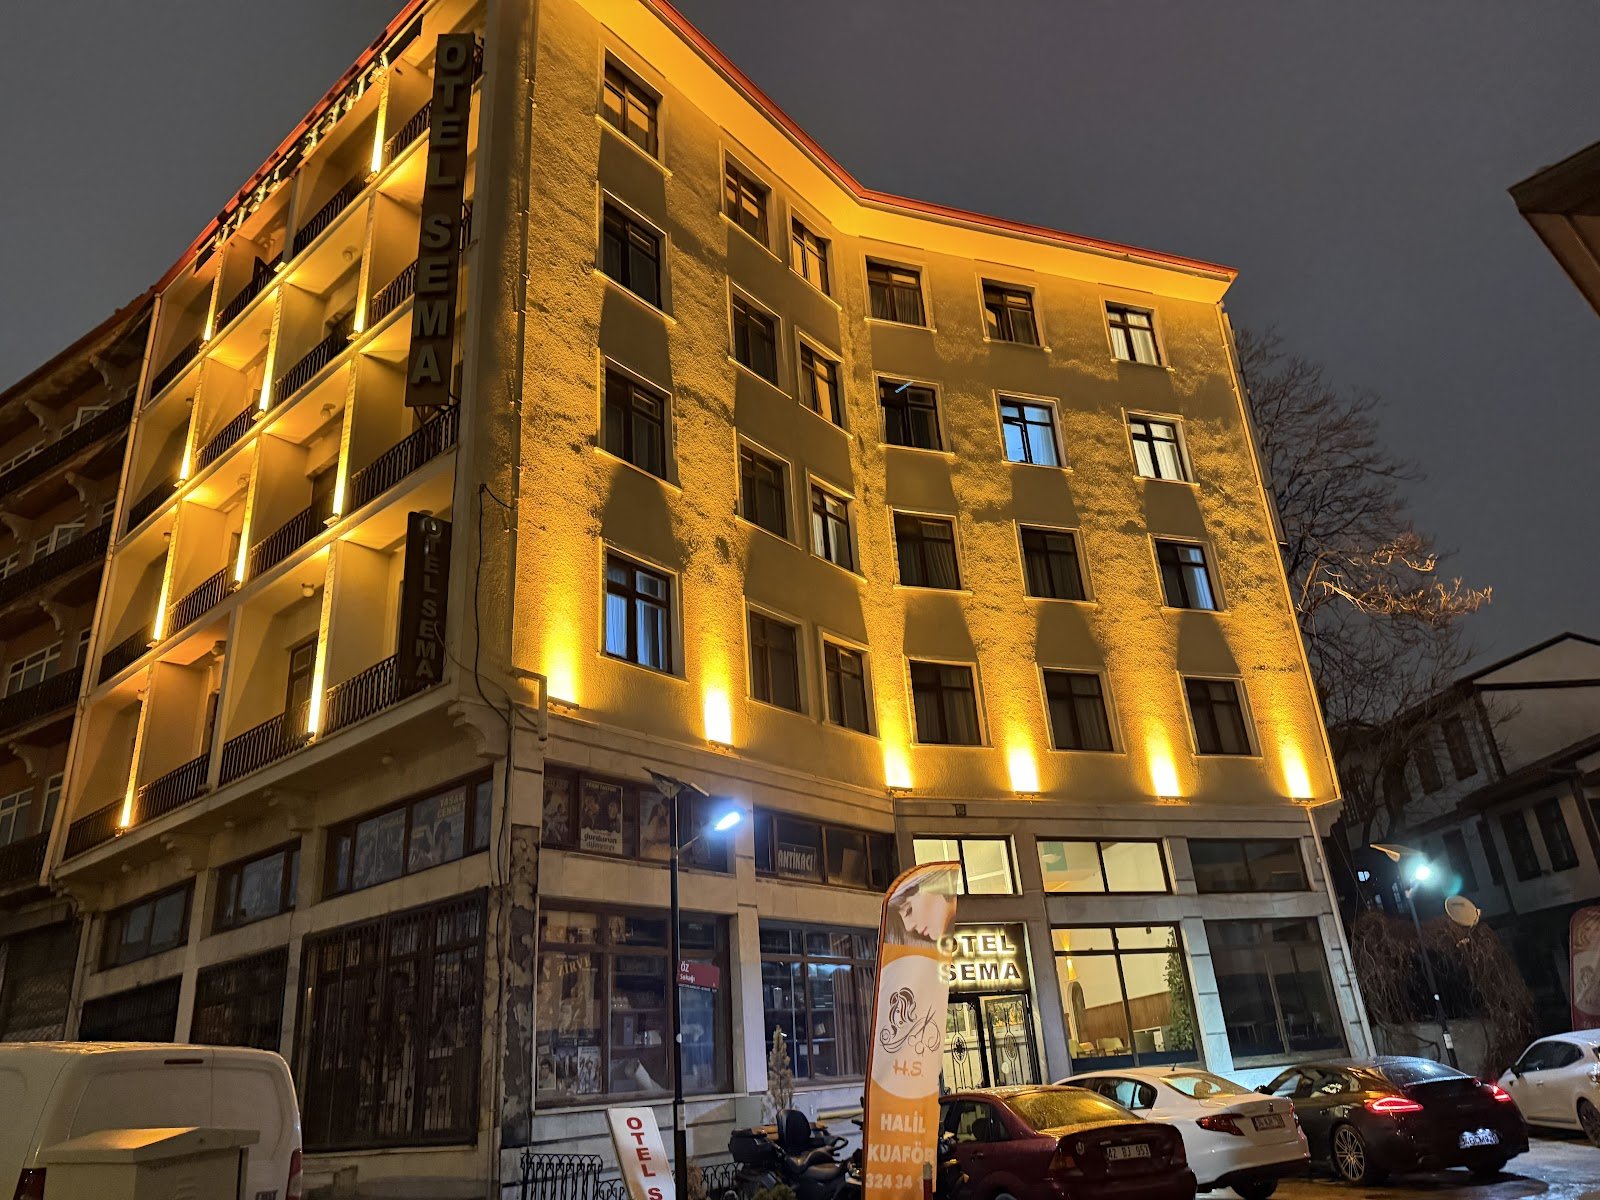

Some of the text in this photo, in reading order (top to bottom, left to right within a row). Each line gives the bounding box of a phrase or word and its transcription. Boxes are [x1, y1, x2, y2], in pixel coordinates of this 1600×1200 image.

[411, 40, 468, 384] OTEL SEMA
[415, 517, 441, 679] OTEL SEMA
[778, 847, 814, 872] ANTİKACI
[938, 932, 1016, 955] OTEL
[680, 960, 690, 973] ÖZ
[680, 973, 696, 983] Sokağı
[939, 961, 1021, 982] SEMA
[892, 1060, 923, 1077] H.S.
[880, 1111, 926, 1134] HALİL
[626, 1116, 656, 1178] OTEL
[868, 1141, 935, 1165] KUAFÖR
[866, 1173, 893, 1189] 324
[895, 1174, 913, 1190] 34
